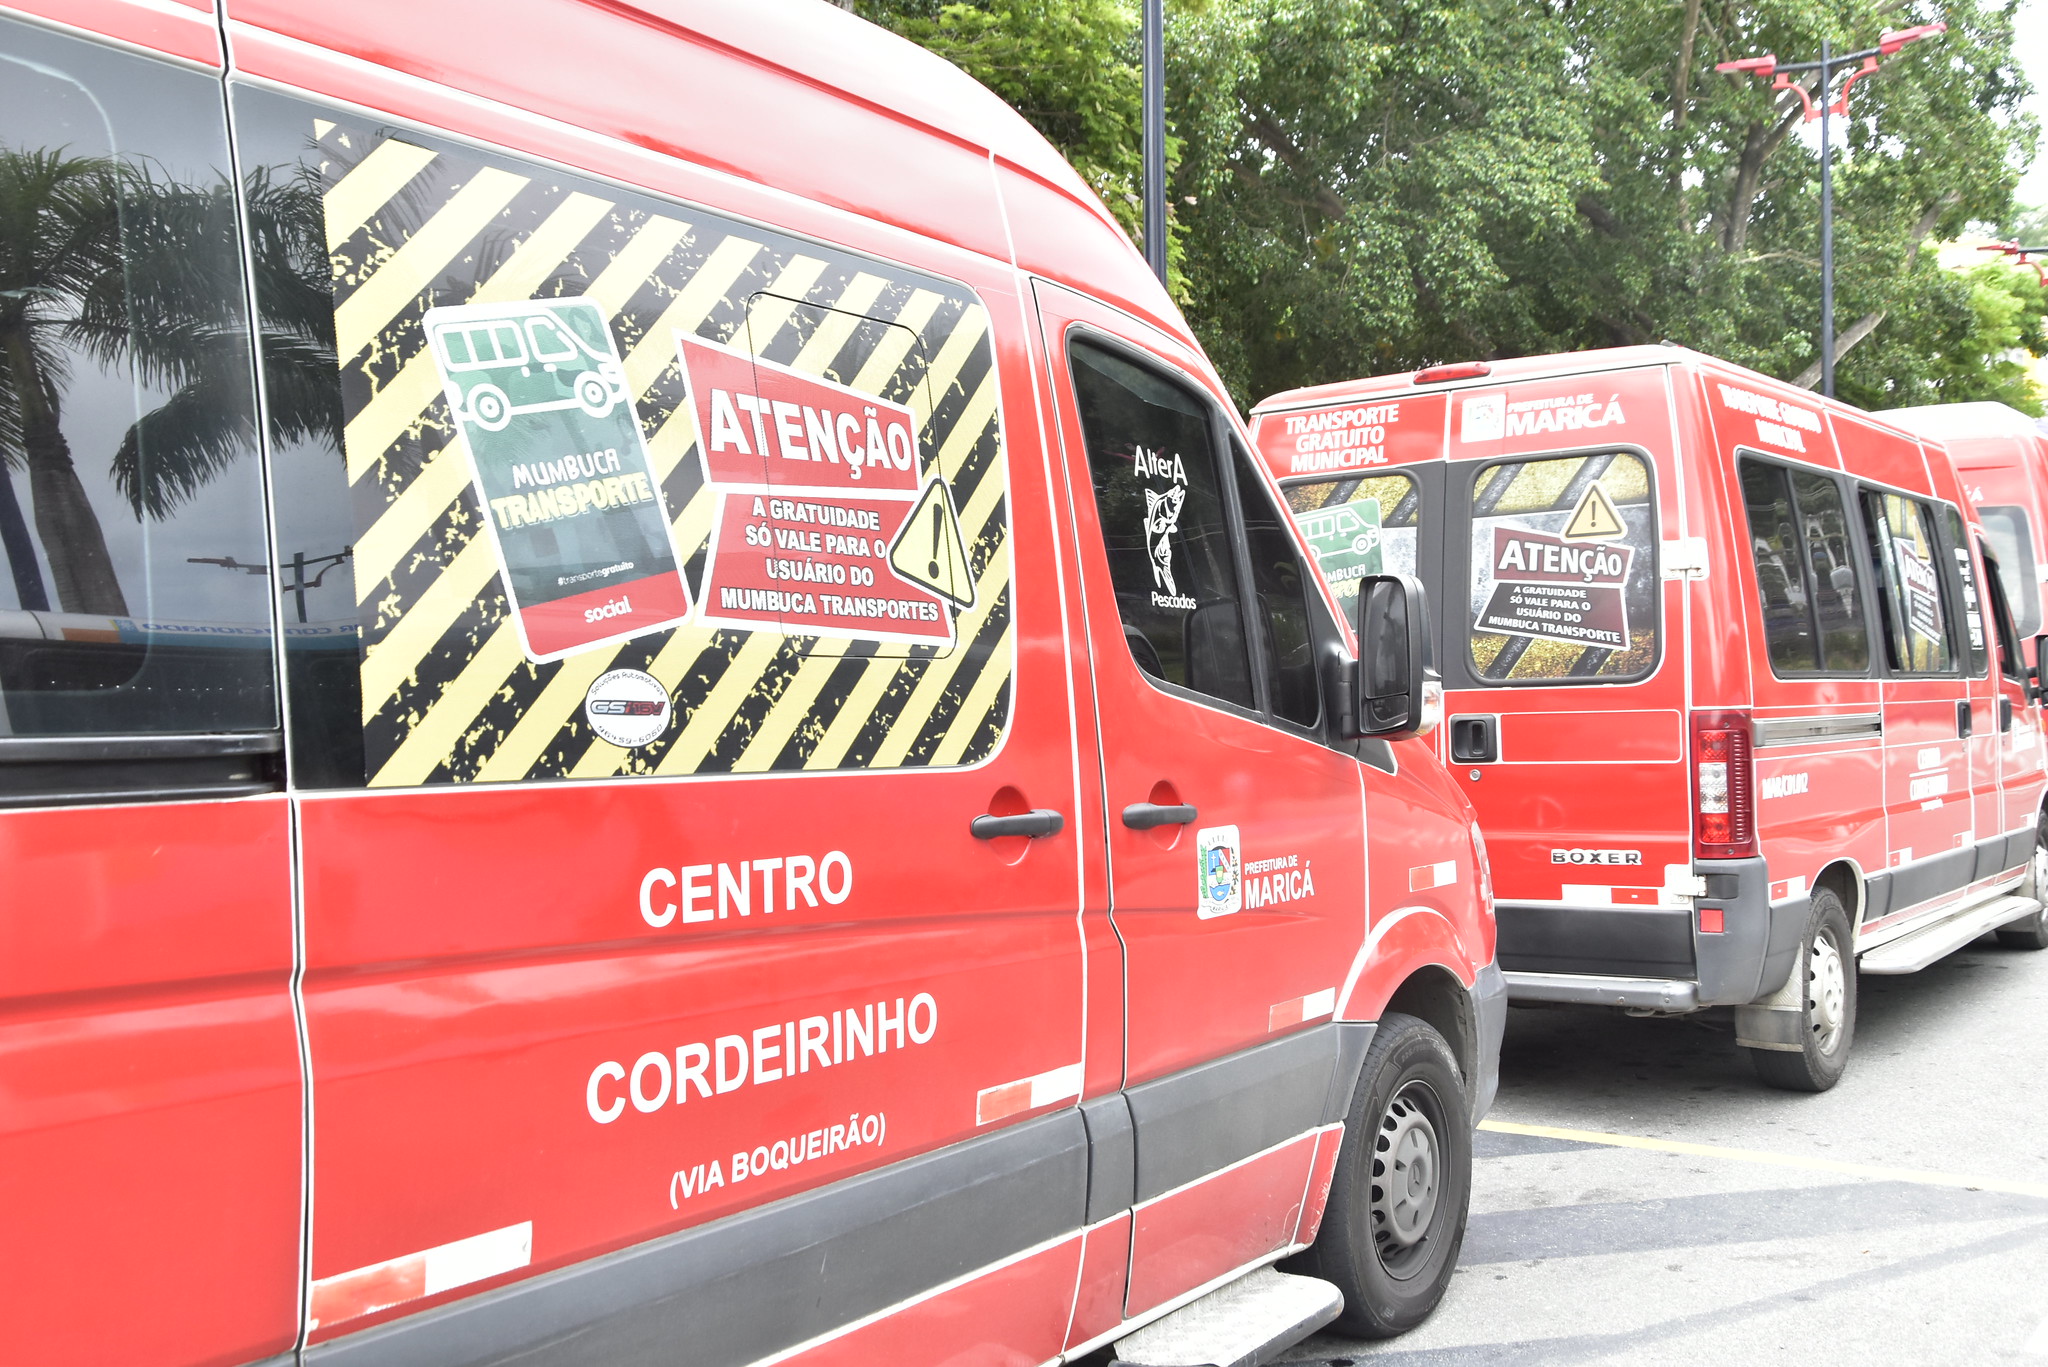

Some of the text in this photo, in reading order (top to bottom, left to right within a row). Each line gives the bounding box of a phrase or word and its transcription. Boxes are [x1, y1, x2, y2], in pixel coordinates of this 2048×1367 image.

[1285, 404, 1399, 436] TRANSPORTE
[1505, 393, 1626, 437] MARICÁ
[1507, 393, 1594, 413] PREFEITURA DE
[710, 388, 913, 480] ATENÇÃO
[1295, 425, 1385, 453] GRATUITO
[512, 448, 621, 489] MUMBUCA
[1134, 445, 1188, 486] AlterA
[1290, 445, 1388, 473] MUNICIPAL
[490, 471, 654, 530] TRANSPORTE
[752, 496, 880, 531] A GRATUIDADE
[745, 522, 886, 559] SÓ VALE PARA O
[765, 553, 874, 587] USUÁRIO DO
[1498, 540, 1622, 581] ATENÇÃO
[584, 595, 632, 623] social
[720, 587, 939, 622] MUMBUCA TRANSPORTES
[1151, 591, 1197, 610] Pescados
[1510, 594, 1591, 611] SÓ VALE PARA O
[1522, 586, 1587, 599] GRATUIDADE
[1488, 615, 1621, 643] MUMBUCA TRANSPORTE
[1516, 606, 1582, 623] USUÁRIO DO
[1244, 854, 1298, 875] PREFEITURA DE
[1552, 851, 1640, 864] BOXER
[639, 850, 853, 928] CENTRO
[1244, 860, 1315, 910] MARICÁ
[586, 992, 938, 1124] CORDEIRINHO
[669, 1111, 886, 1210] (VIA BOQUEIRÃO)
